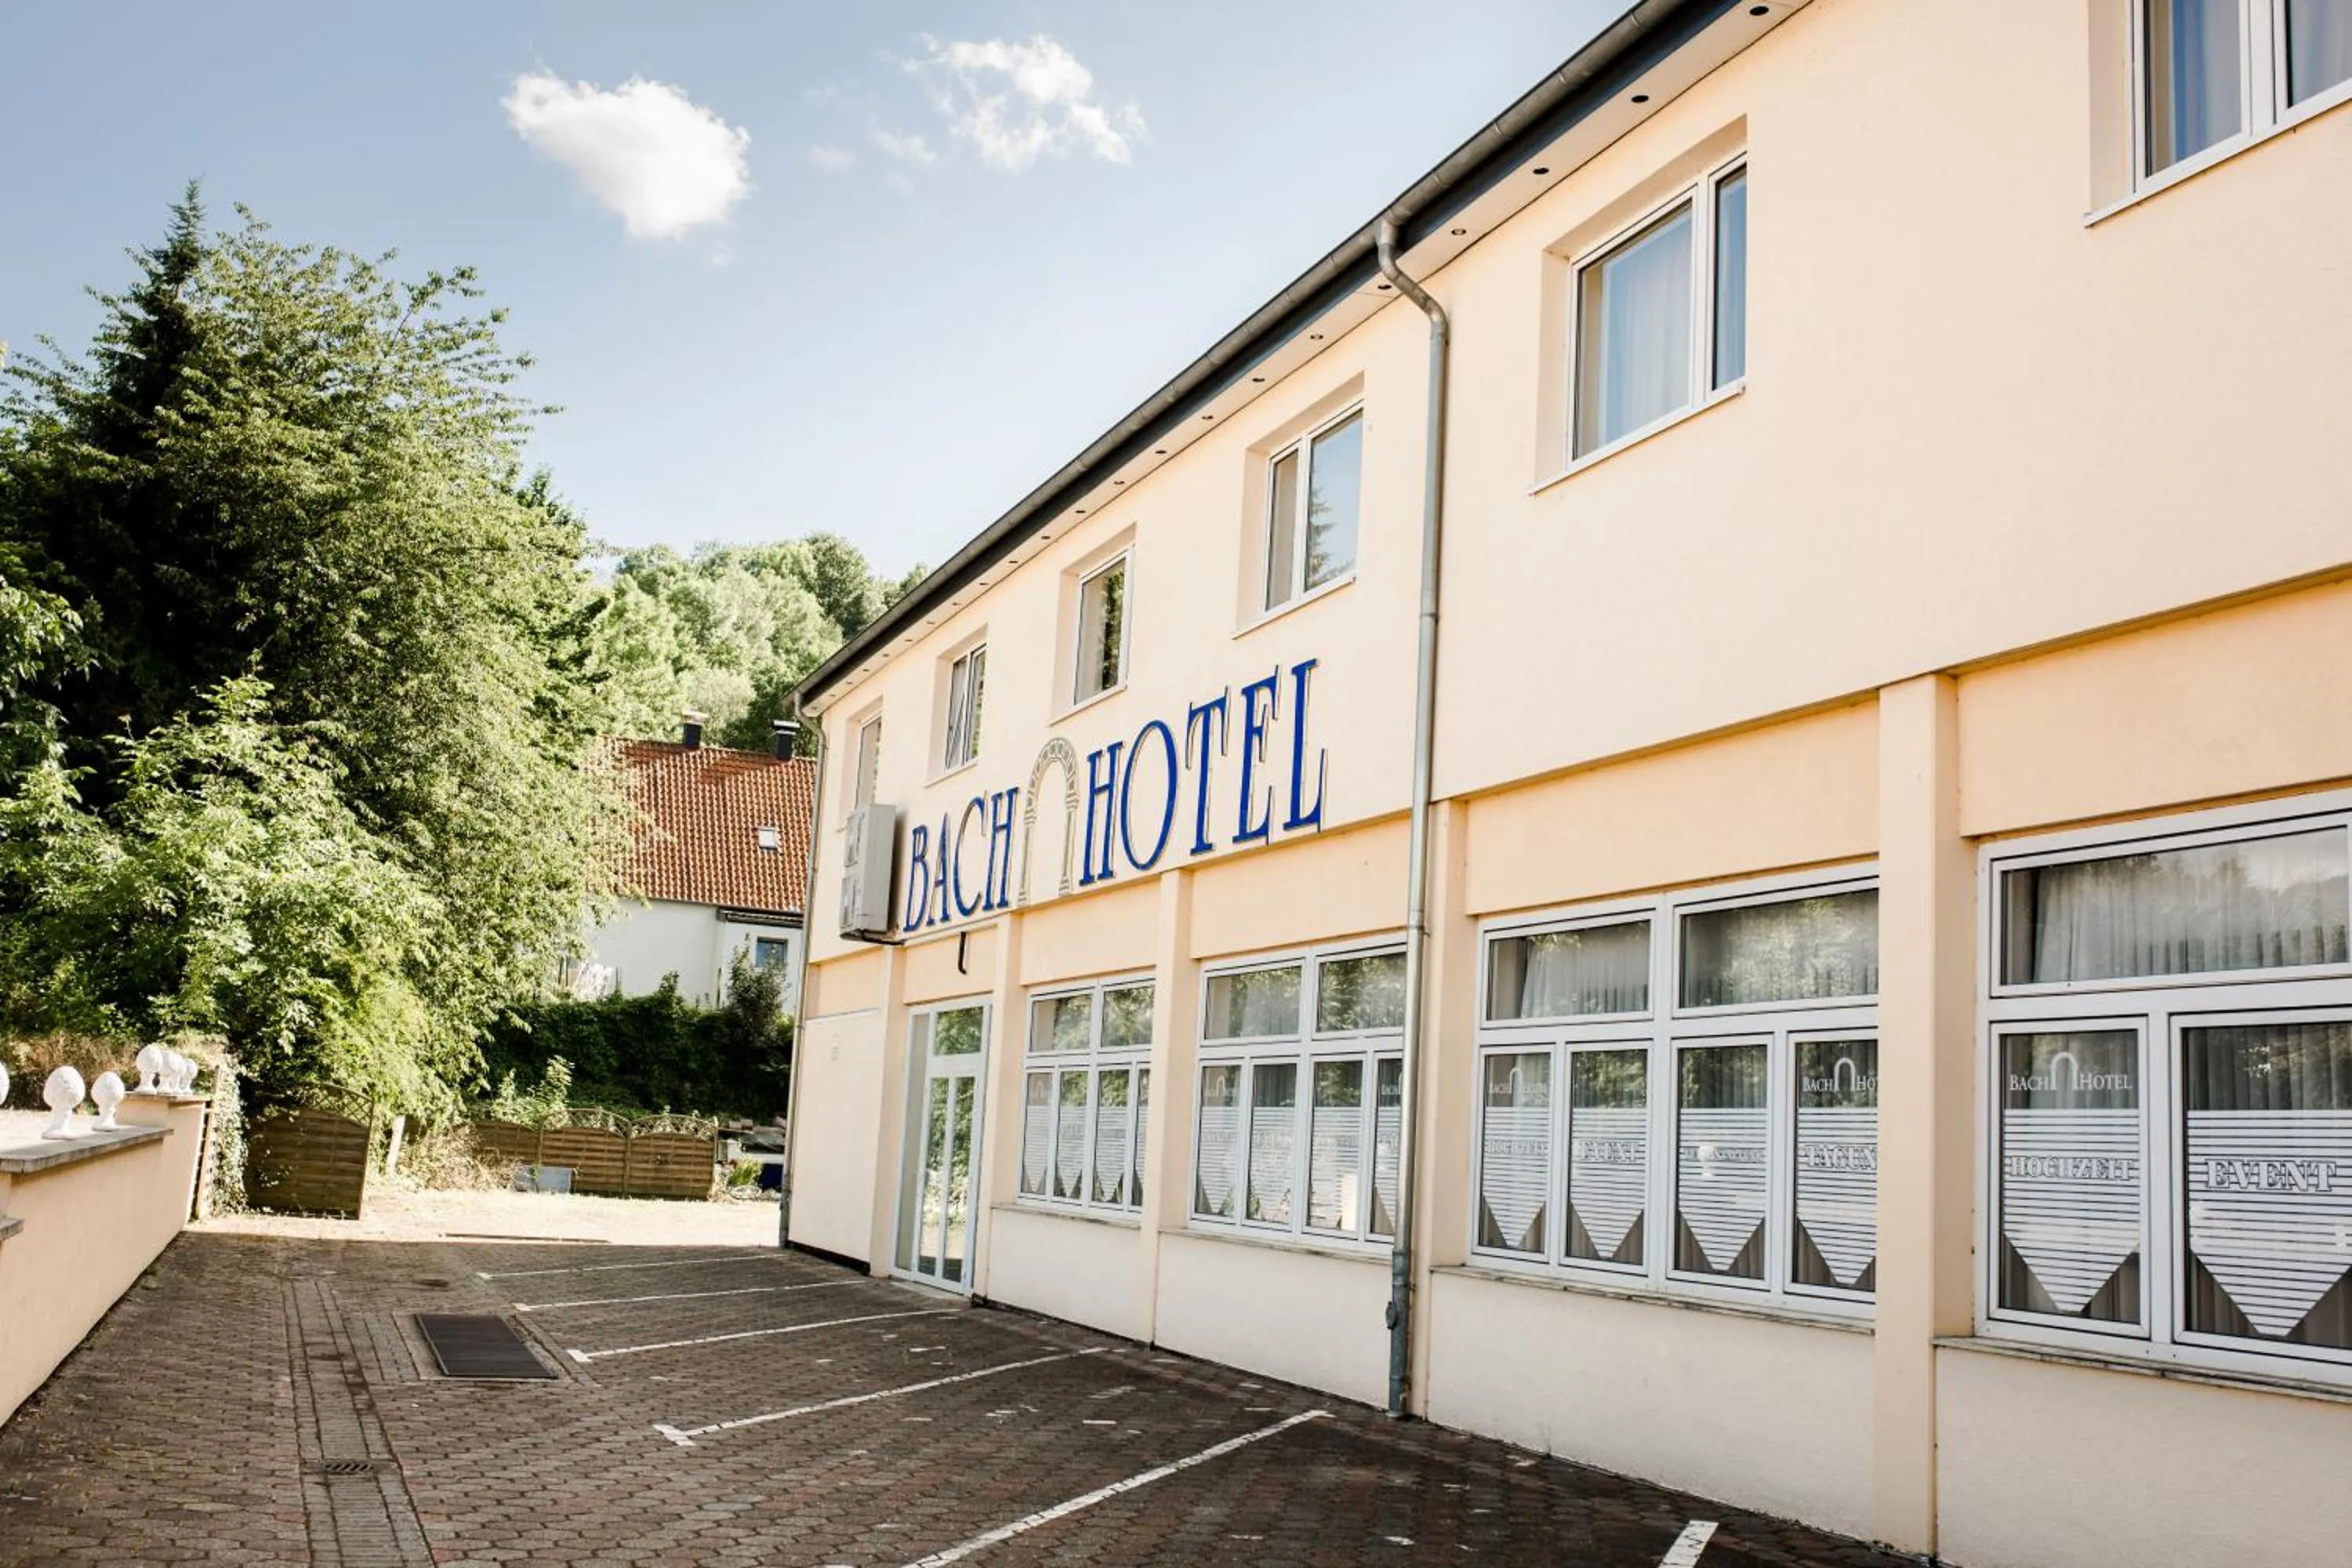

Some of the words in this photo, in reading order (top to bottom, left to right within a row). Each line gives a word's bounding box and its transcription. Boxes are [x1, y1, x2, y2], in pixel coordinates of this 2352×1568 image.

[903, 787, 1018, 932] BACH
[1080, 659, 1327, 887] HOTEL
[1803, 1076, 1834, 1091] BACH
[2009, 1074, 2049, 1091] BACH
[2079, 1072, 2132, 1091] HOTEL
[1805, 1144, 1877, 1170] TAGUN
[2009, 1155, 2134, 1181] HOCHZEIT
[2204, 1158, 2337, 1192] EVENT
